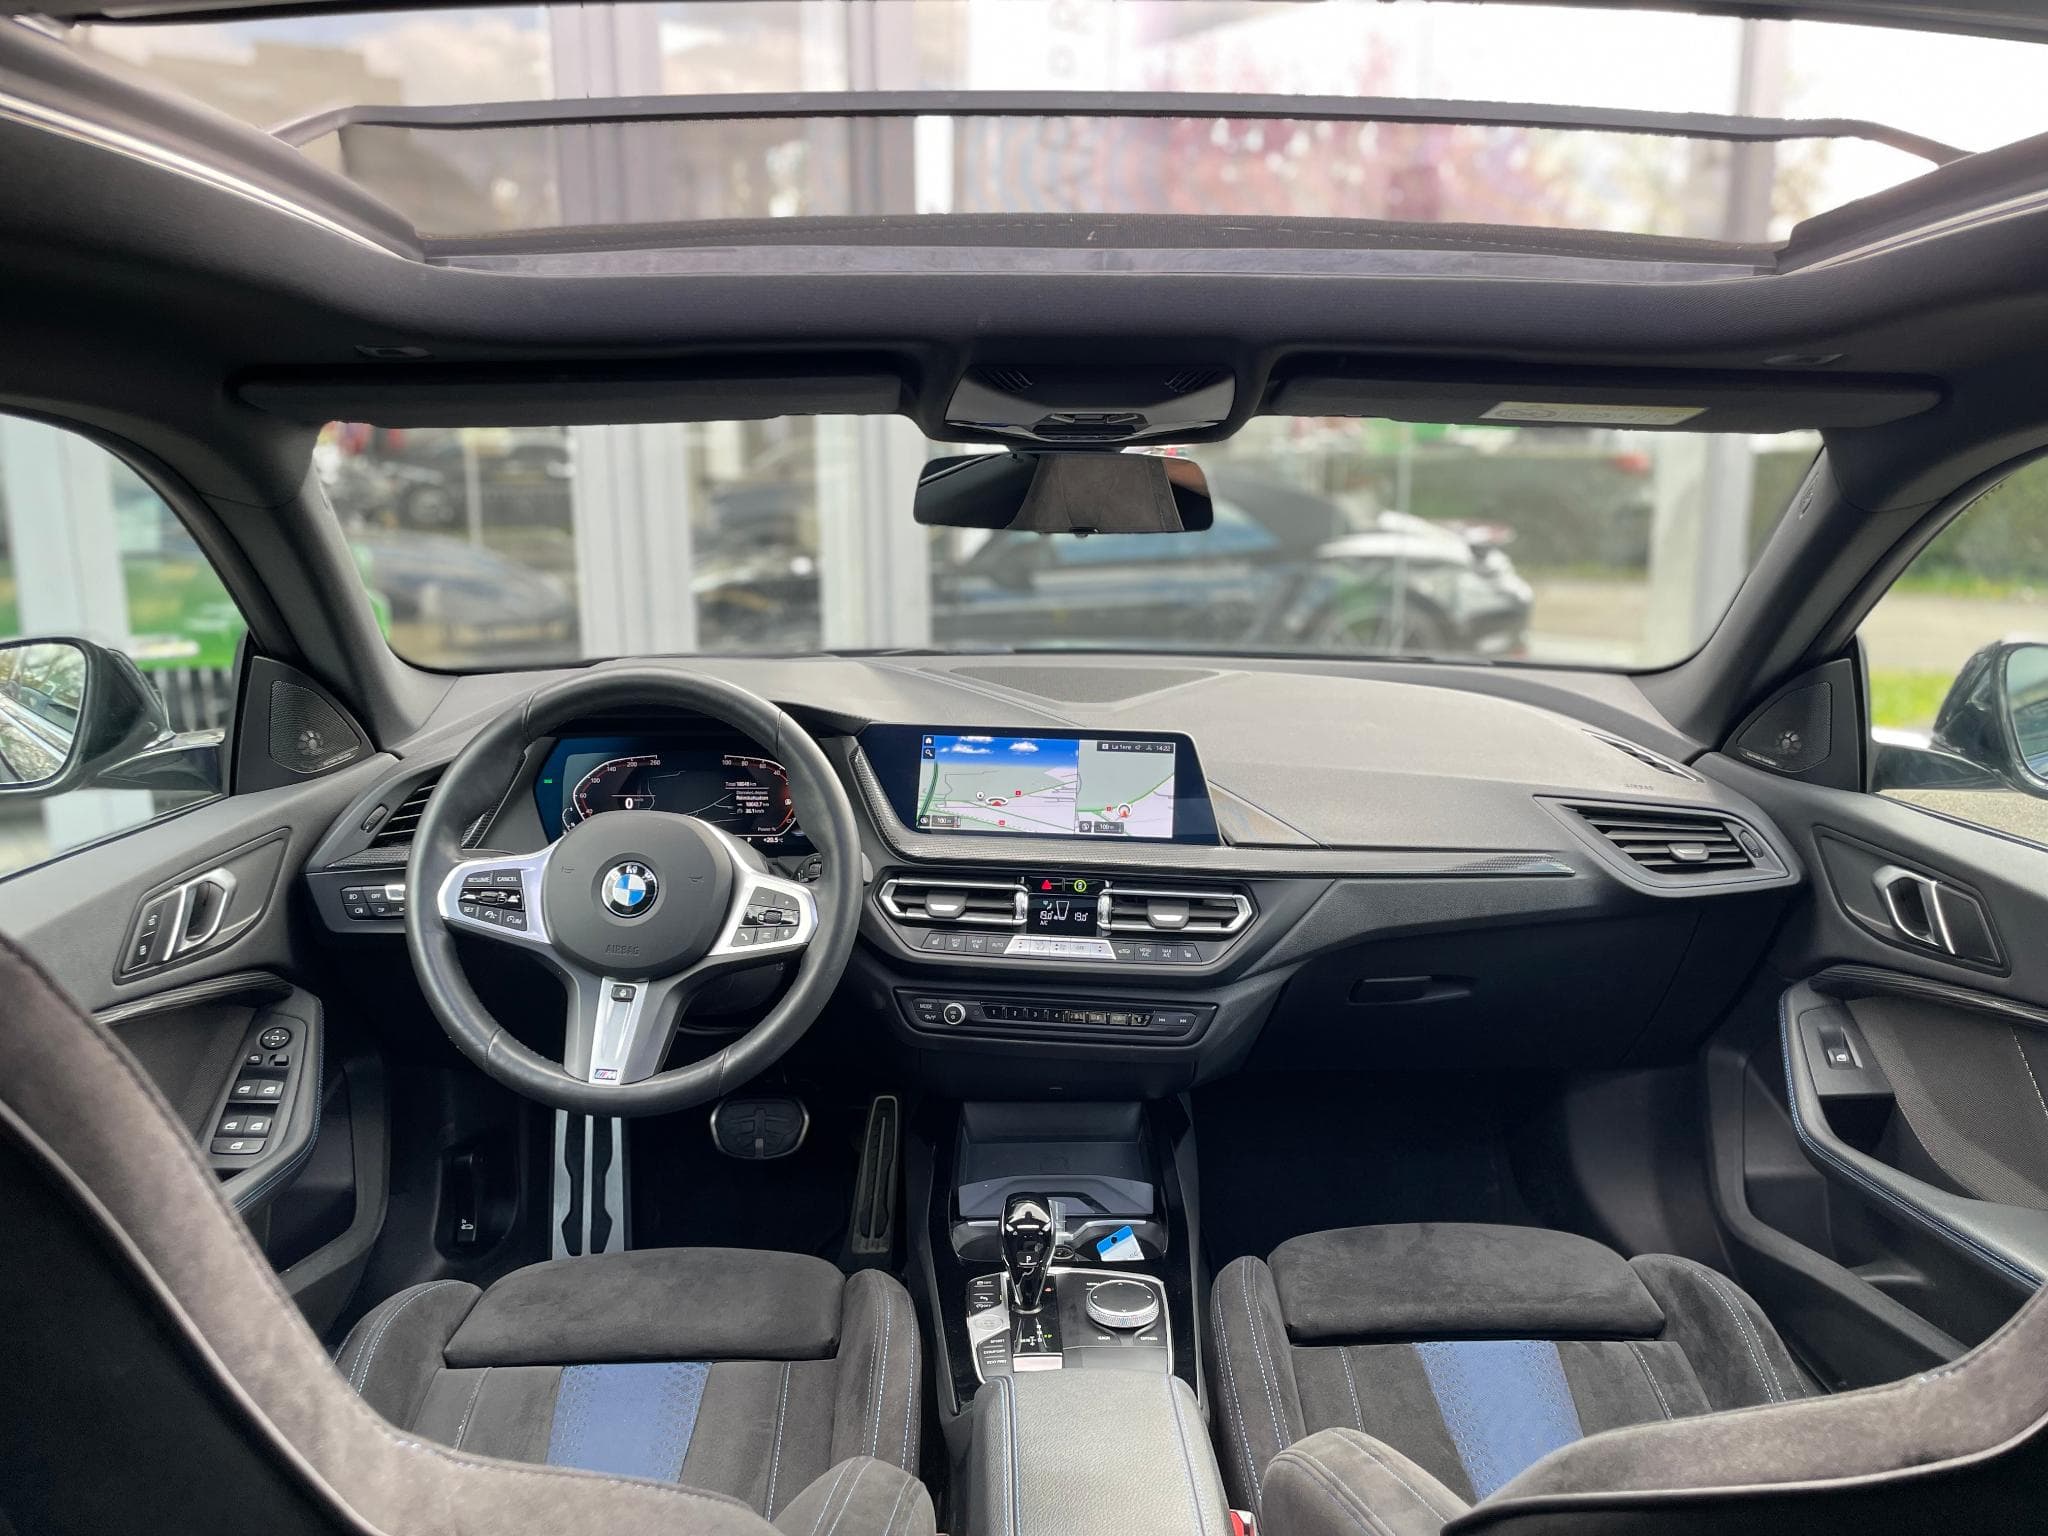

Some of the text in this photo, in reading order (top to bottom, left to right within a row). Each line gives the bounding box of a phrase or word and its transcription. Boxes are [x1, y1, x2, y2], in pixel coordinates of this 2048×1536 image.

[624, 797, 634, 810] 0
[604, 944, 640, 955] AIRBAG
[1026, 1255, 1032, 1263] P
